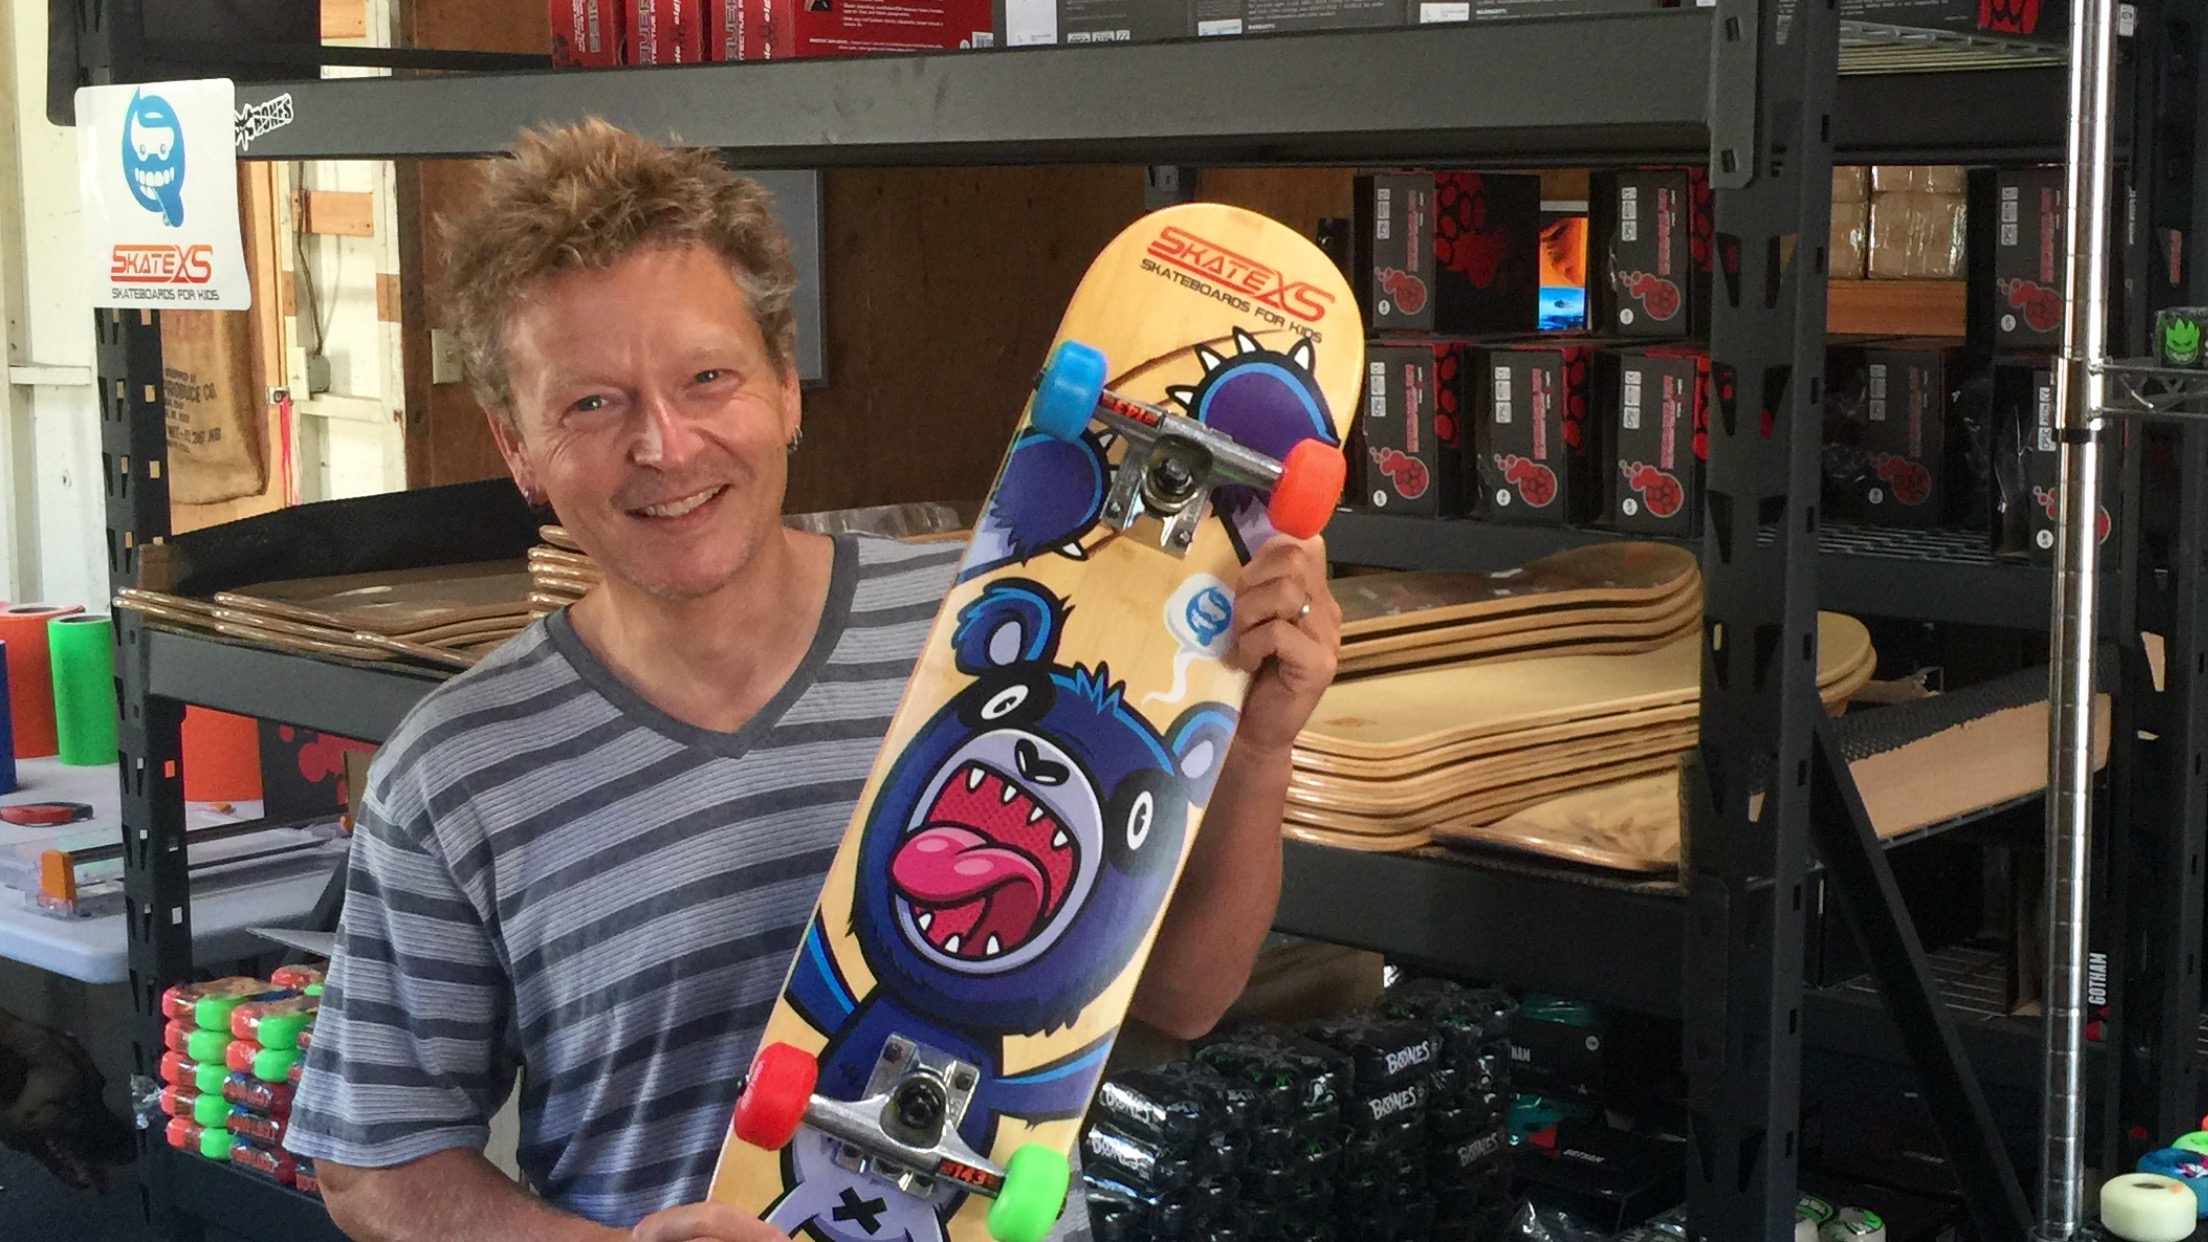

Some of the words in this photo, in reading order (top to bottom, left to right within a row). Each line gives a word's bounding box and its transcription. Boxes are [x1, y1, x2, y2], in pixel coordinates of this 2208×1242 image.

[111, 244, 213, 283] SKATEXS
[1147, 226, 1336, 322] SKATEXS
[112, 288, 175, 299] SKATEBOARDS
[177, 289, 195, 300] FOR
[198, 290, 219, 300] KIDS
[1140, 258, 1250, 312] SKATEBOARDS
[1254, 307, 1286, 327] FOR
[1289, 321, 1323, 343] KIDS
[2088, 952, 2107, 1005] GOTHAM
[1385, 1041, 1430, 1075] BONES
[1369, 1086, 1416, 1120] BONES
[1457, 1132, 1499, 1167] BONES
